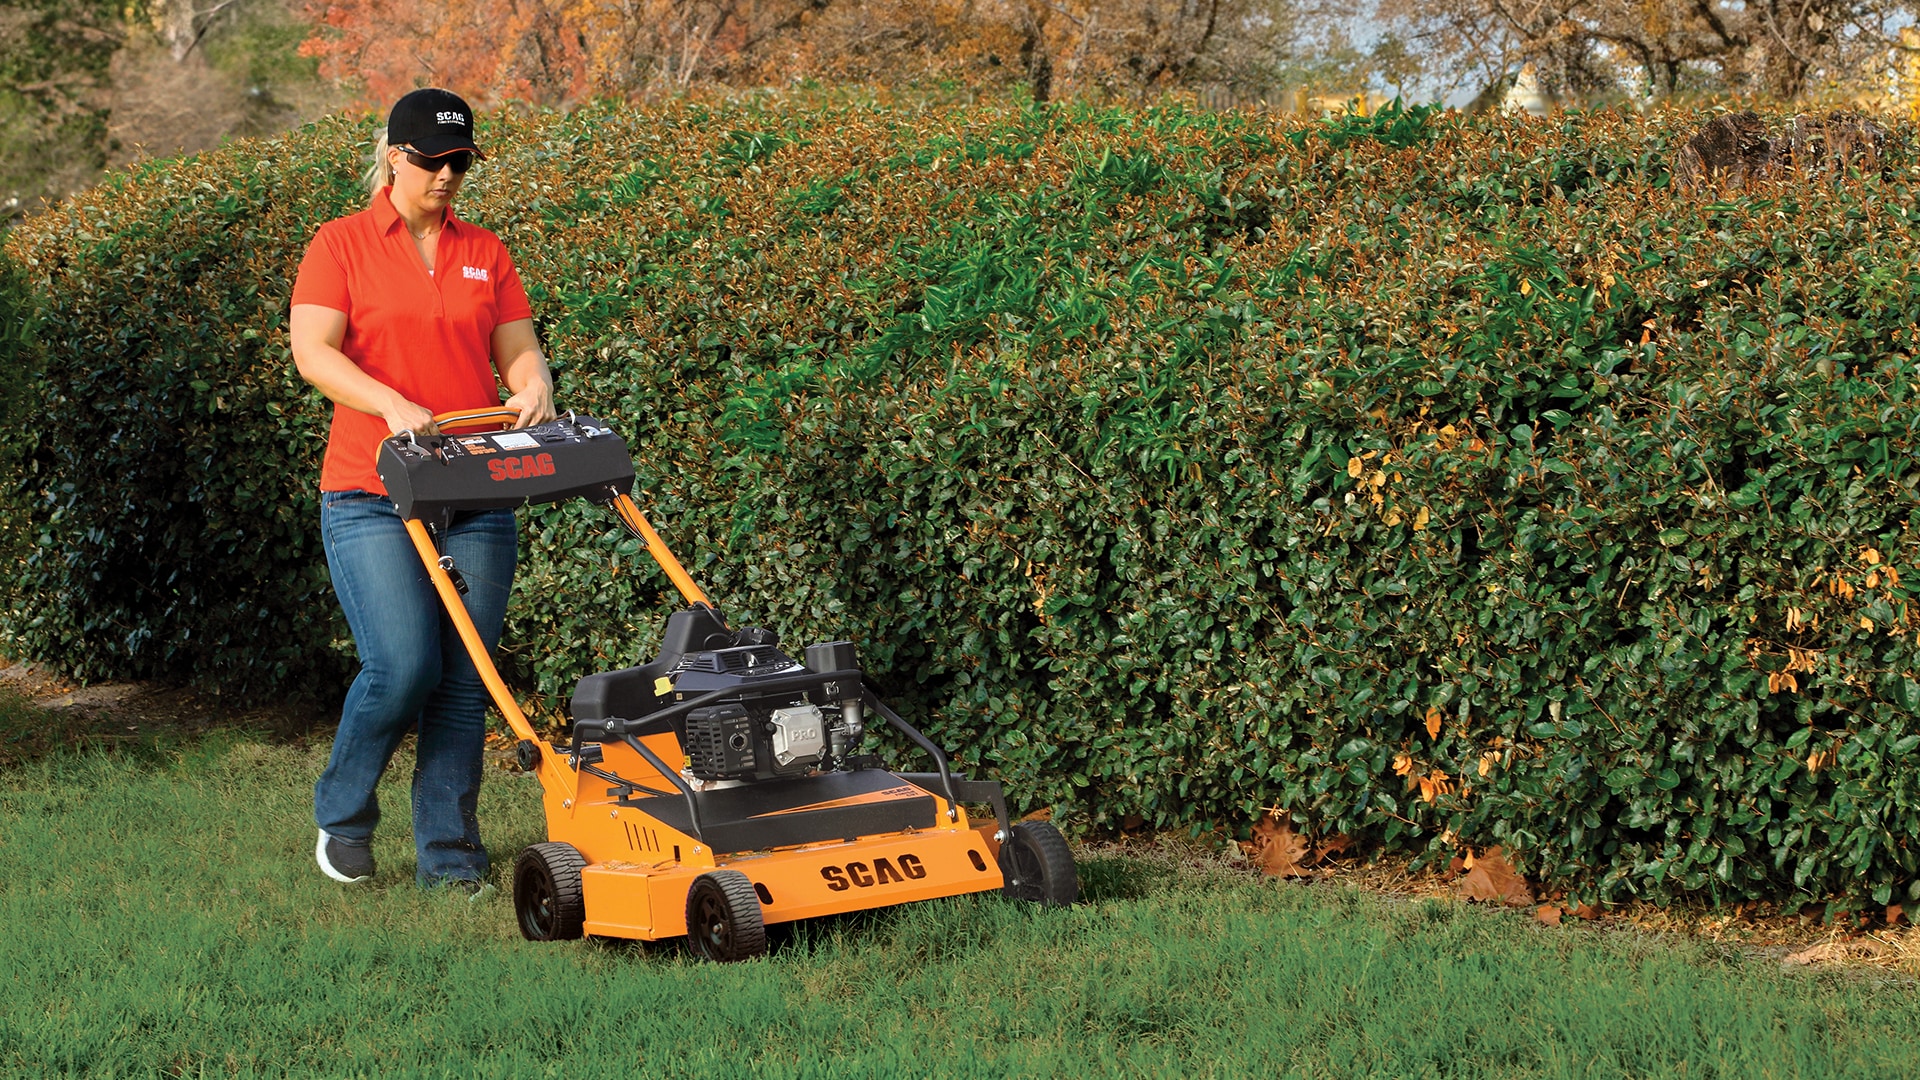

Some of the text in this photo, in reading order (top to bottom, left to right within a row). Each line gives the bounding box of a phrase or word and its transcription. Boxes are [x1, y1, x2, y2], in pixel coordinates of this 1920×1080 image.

[436, 111, 465, 122] SCAG
[462, 266, 488, 278] SCAG
[487, 452, 556, 481] SCAG
[791, 728, 817, 742] PRO
[820, 853, 927, 892] SCAG
